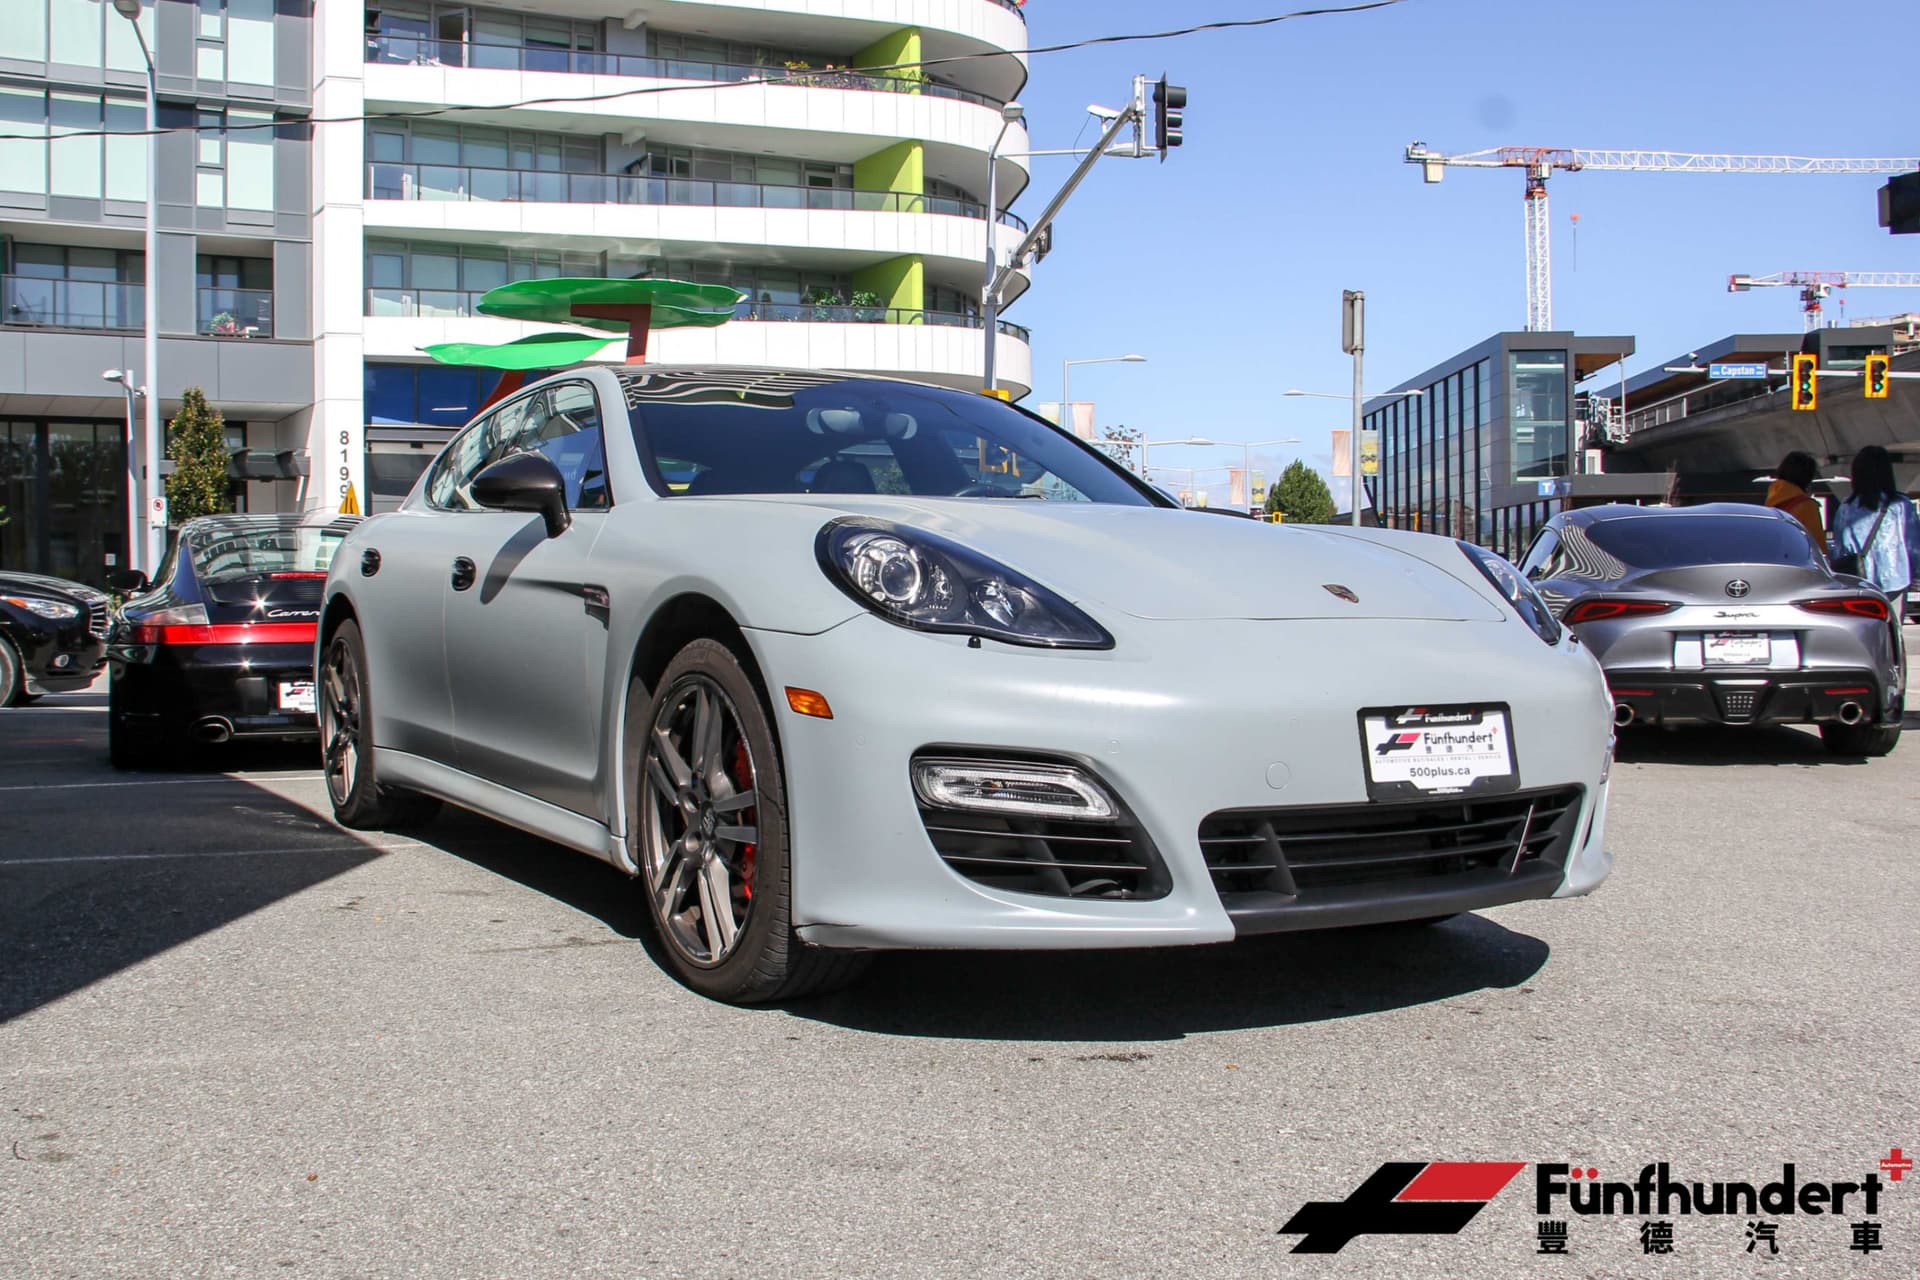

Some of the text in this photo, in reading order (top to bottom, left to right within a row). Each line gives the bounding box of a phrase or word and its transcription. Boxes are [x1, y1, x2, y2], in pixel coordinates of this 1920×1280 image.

[1721, 367, 1755, 376] Capstan
[1542, 482, 1551, 493] T
[1713, 611, 1760, 620] Supra
[1424, 732, 1493, 744] Fünfhundert
[1410, 767, 1471, 777] 500plus.ca
